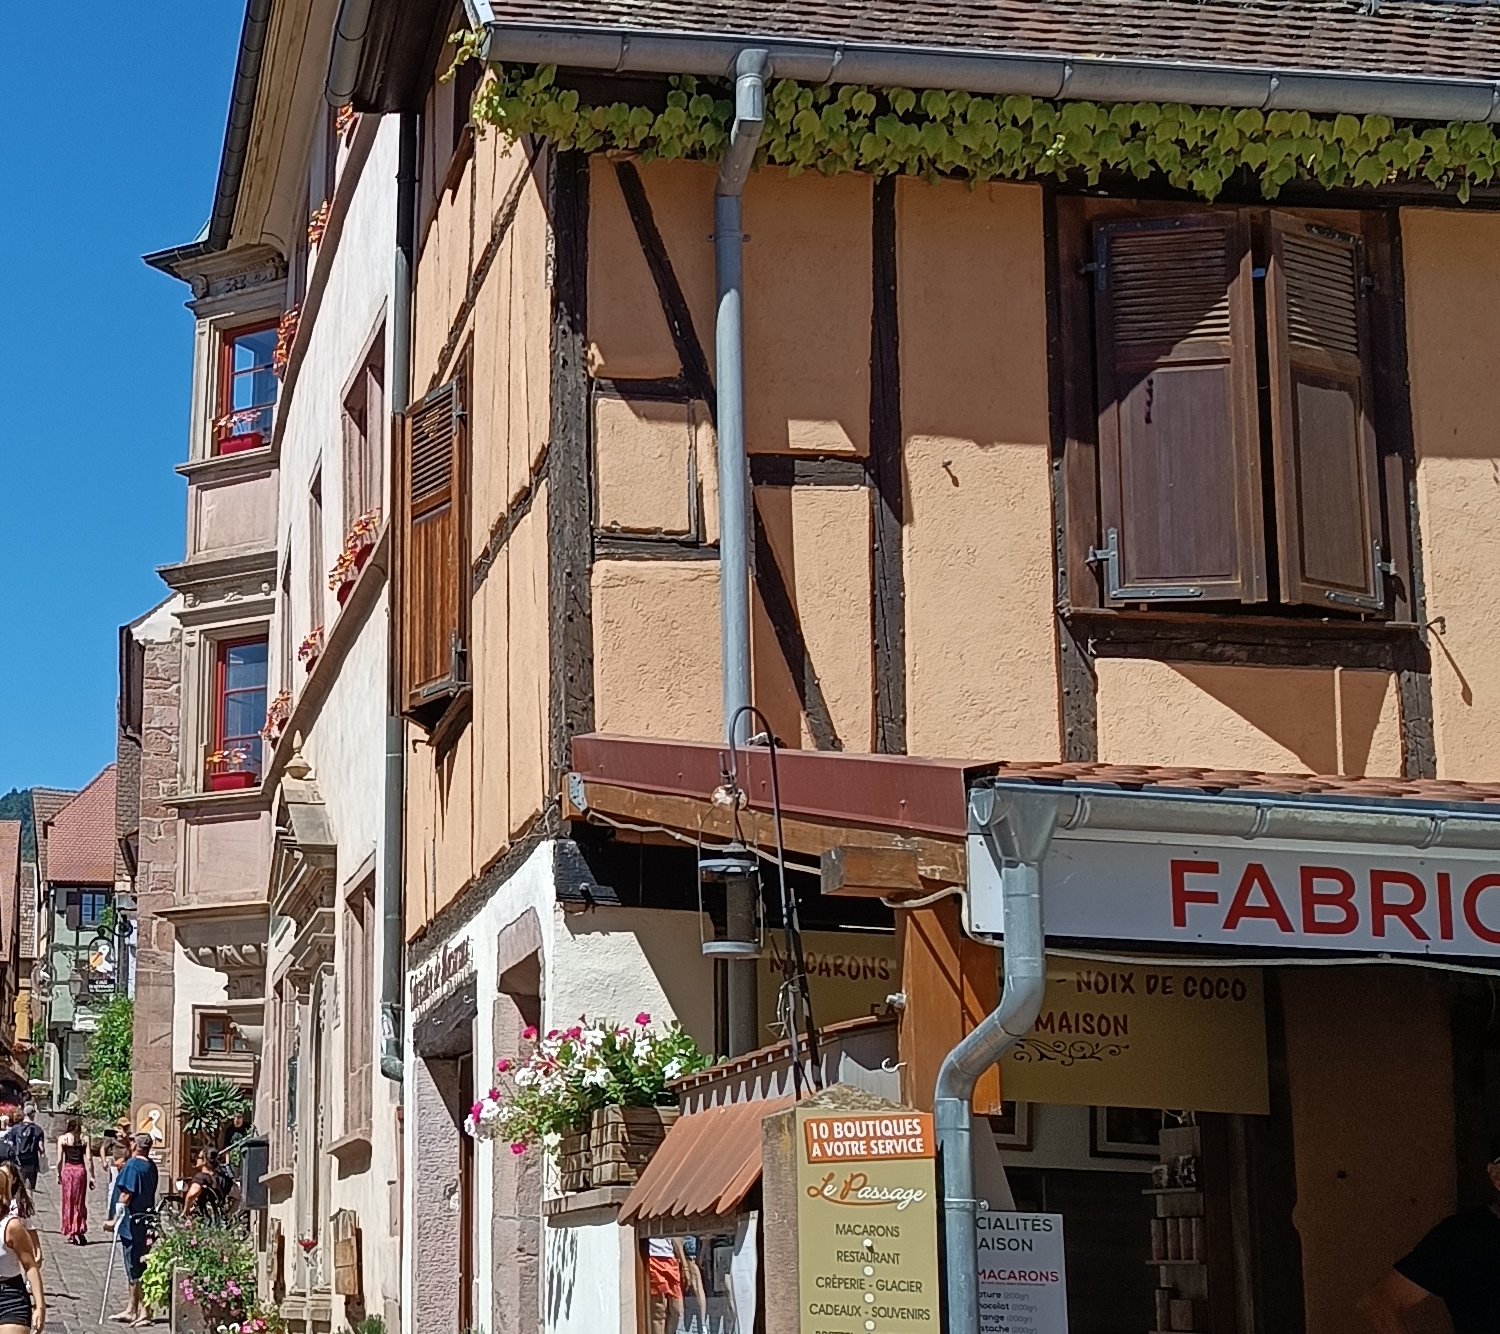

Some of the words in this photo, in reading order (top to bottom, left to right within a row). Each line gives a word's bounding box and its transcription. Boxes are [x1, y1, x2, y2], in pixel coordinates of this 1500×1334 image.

[1076, 970, 1136, 995] NOIX
[1145, 974, 1174, 995] DE
[1183, 975, 1247, 1002] COCO
[1034, 1011, 1129, 1037] MAISON
[810, 1122, 828, 1139] 10
[833, 1119, 922, 1139] BOUTIQUES
[811, 1142, 821, 1157] A
[823, 1140, 867, 1156] VOTRE
[870, 1137, 924, 1154] SERVICE
[807, 1172, 837, 1198] Le
[840, 1172, 927, 1210] Passage
[835, 1223, 900, 1238] MACARONS
[976, 1215, 1053, 1232] CIALITÉS
[978, 1237, 1033, 1252] AISON
[836, 1250, 900, 1265] RESTAURANT
[816, 1274, 866, 1290] CRÊPERIE
[875, 1279, 922, 1293] GLACIER
[978, 1269, 1059, 1283] MACARONS
[979, 1291, 1002, 1299] ature
[809, 1303, 861, 1317] CADEAUX
[871, 1306, 930, 1321] SOUVENIRS
[980, 1314, 1004, 1323] range
[980, 1325, 1009, 1333] stache
